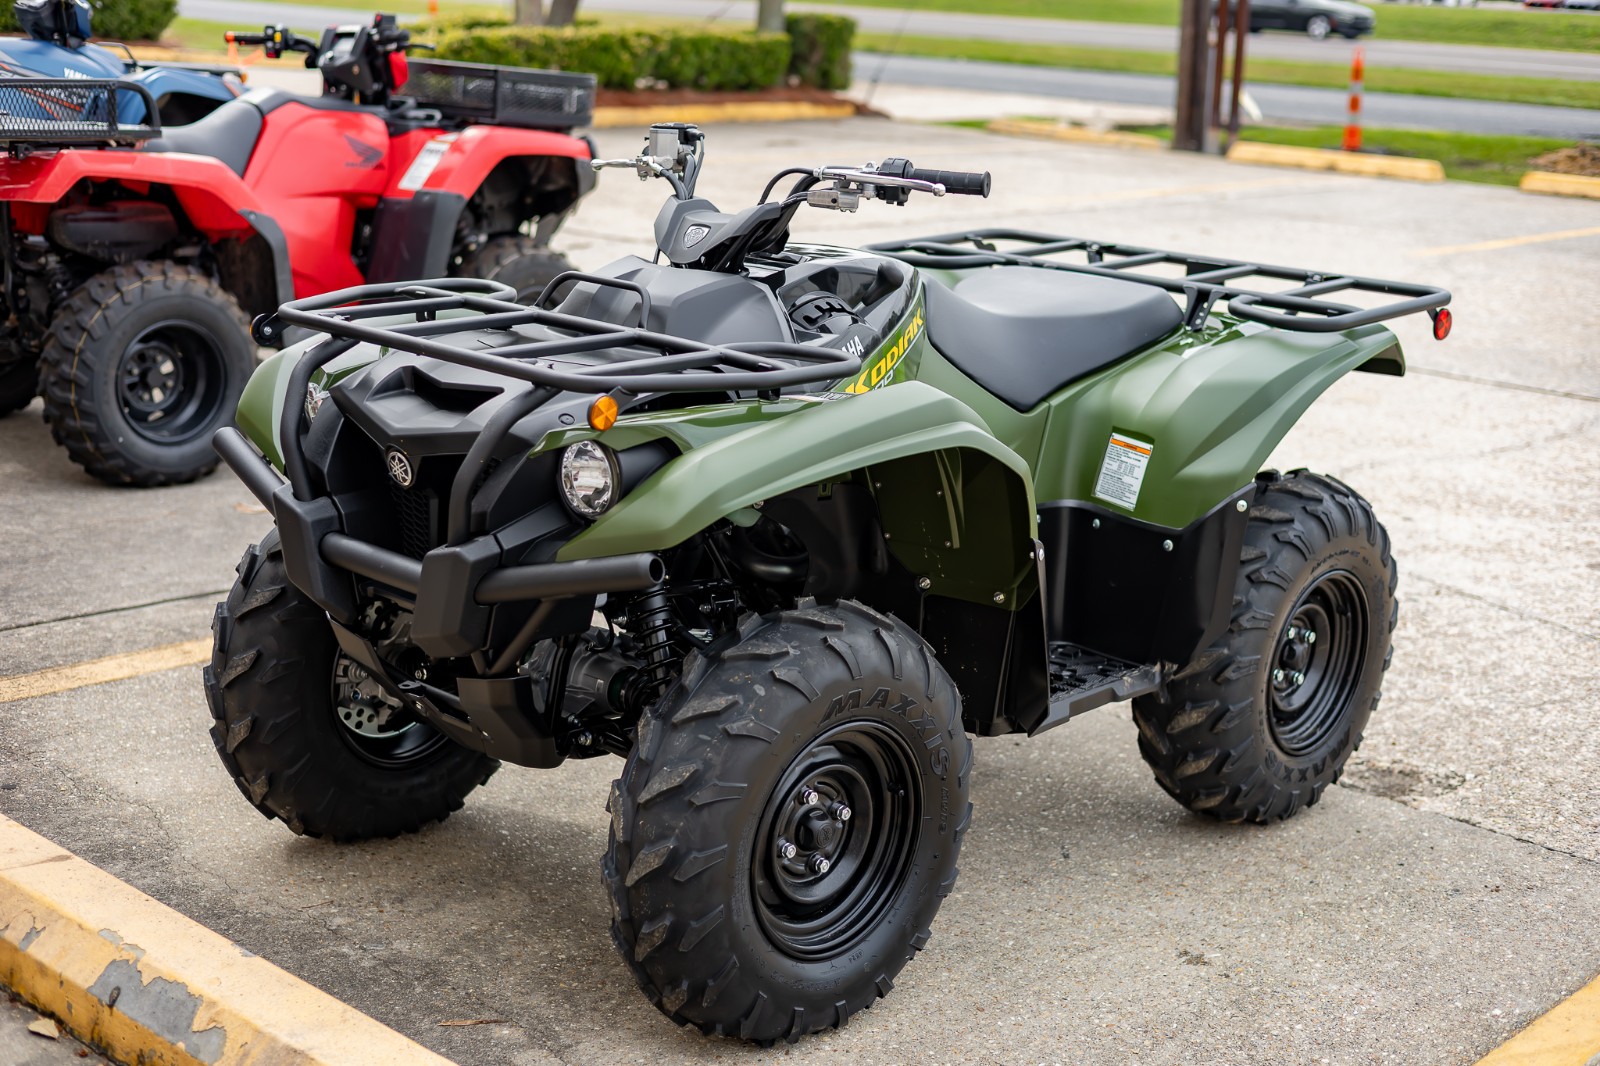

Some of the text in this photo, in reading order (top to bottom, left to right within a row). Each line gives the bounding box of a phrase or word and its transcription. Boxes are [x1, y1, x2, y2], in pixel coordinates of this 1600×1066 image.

[845, 307, 923, 395] KODIAK
[818, 687, 949, 776] MAXXIS
[1265, 726, 1351, 784] MAXXIS
